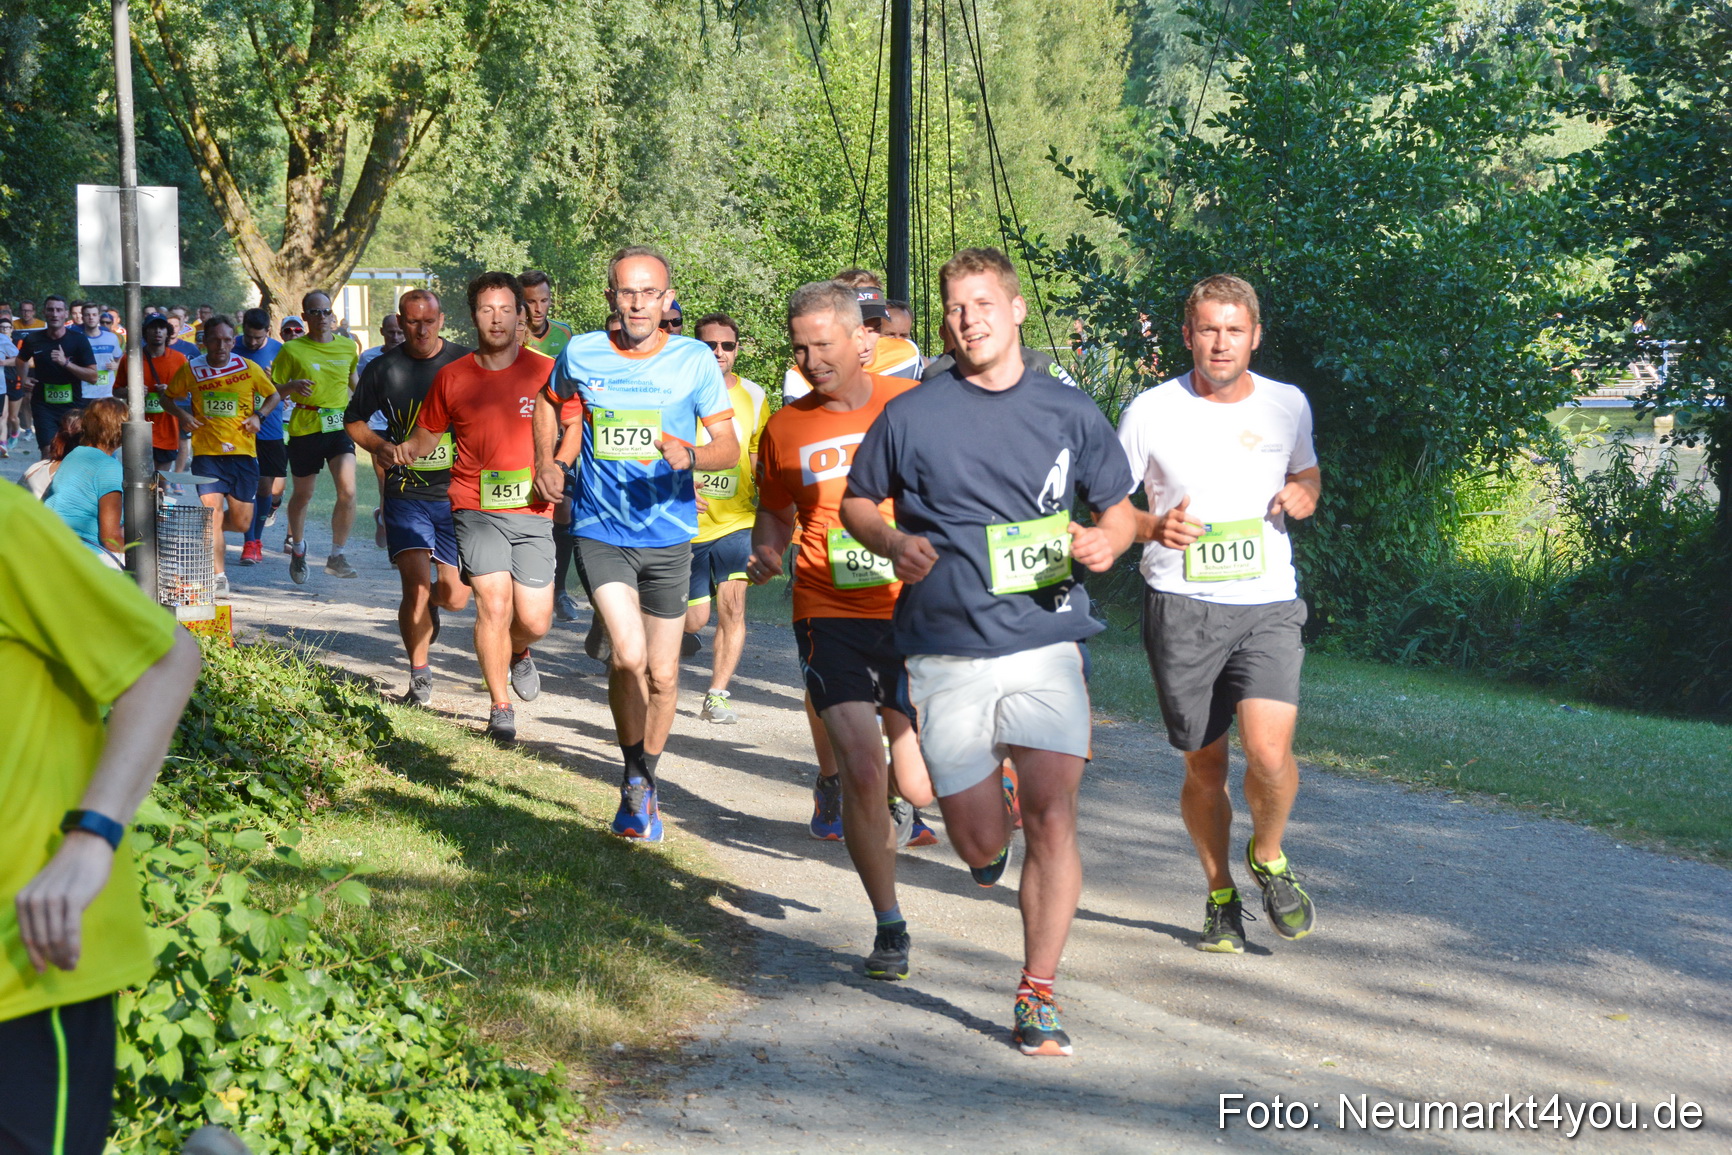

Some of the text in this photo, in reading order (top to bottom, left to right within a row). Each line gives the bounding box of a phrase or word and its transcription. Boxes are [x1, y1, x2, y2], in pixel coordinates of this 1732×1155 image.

[198, 373, 251, 391] MAX BÖGL
[608, 378, 654, 386] Raiffeisenbank
[608, 385, 638, 393] Neumarkt
[206, 400, 233, 411] 1236
[601, 427, 652, 446] 1579
[702, 474, 729, 489] 240
[491, 484, 521, 498] 451
[1004, 540, 1063, 572] 1613
[1197, 540, 1254, 564] 1010
